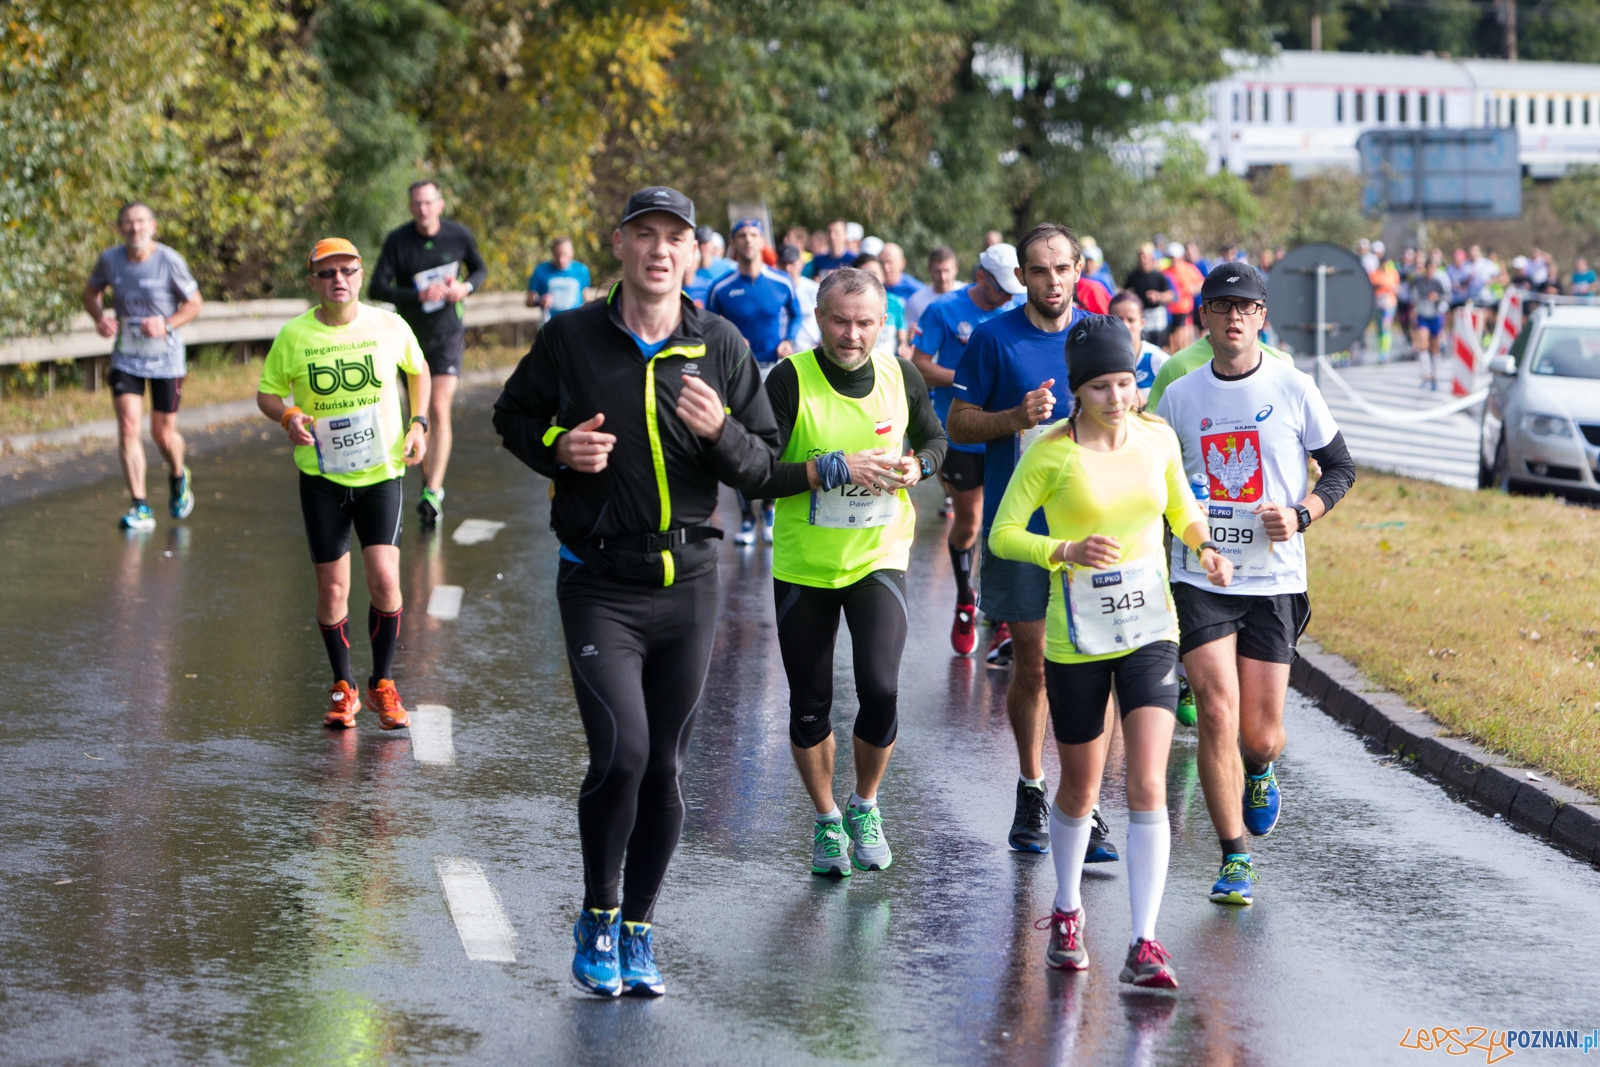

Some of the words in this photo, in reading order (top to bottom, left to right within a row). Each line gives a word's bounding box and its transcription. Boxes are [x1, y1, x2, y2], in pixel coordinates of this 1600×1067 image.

[307, 354, 382, 396] bbl
[313, 399, 354, 411] Zduńska
[332, 427, 375, 450] 5659
[1100, 590, 1145, 615] 343
